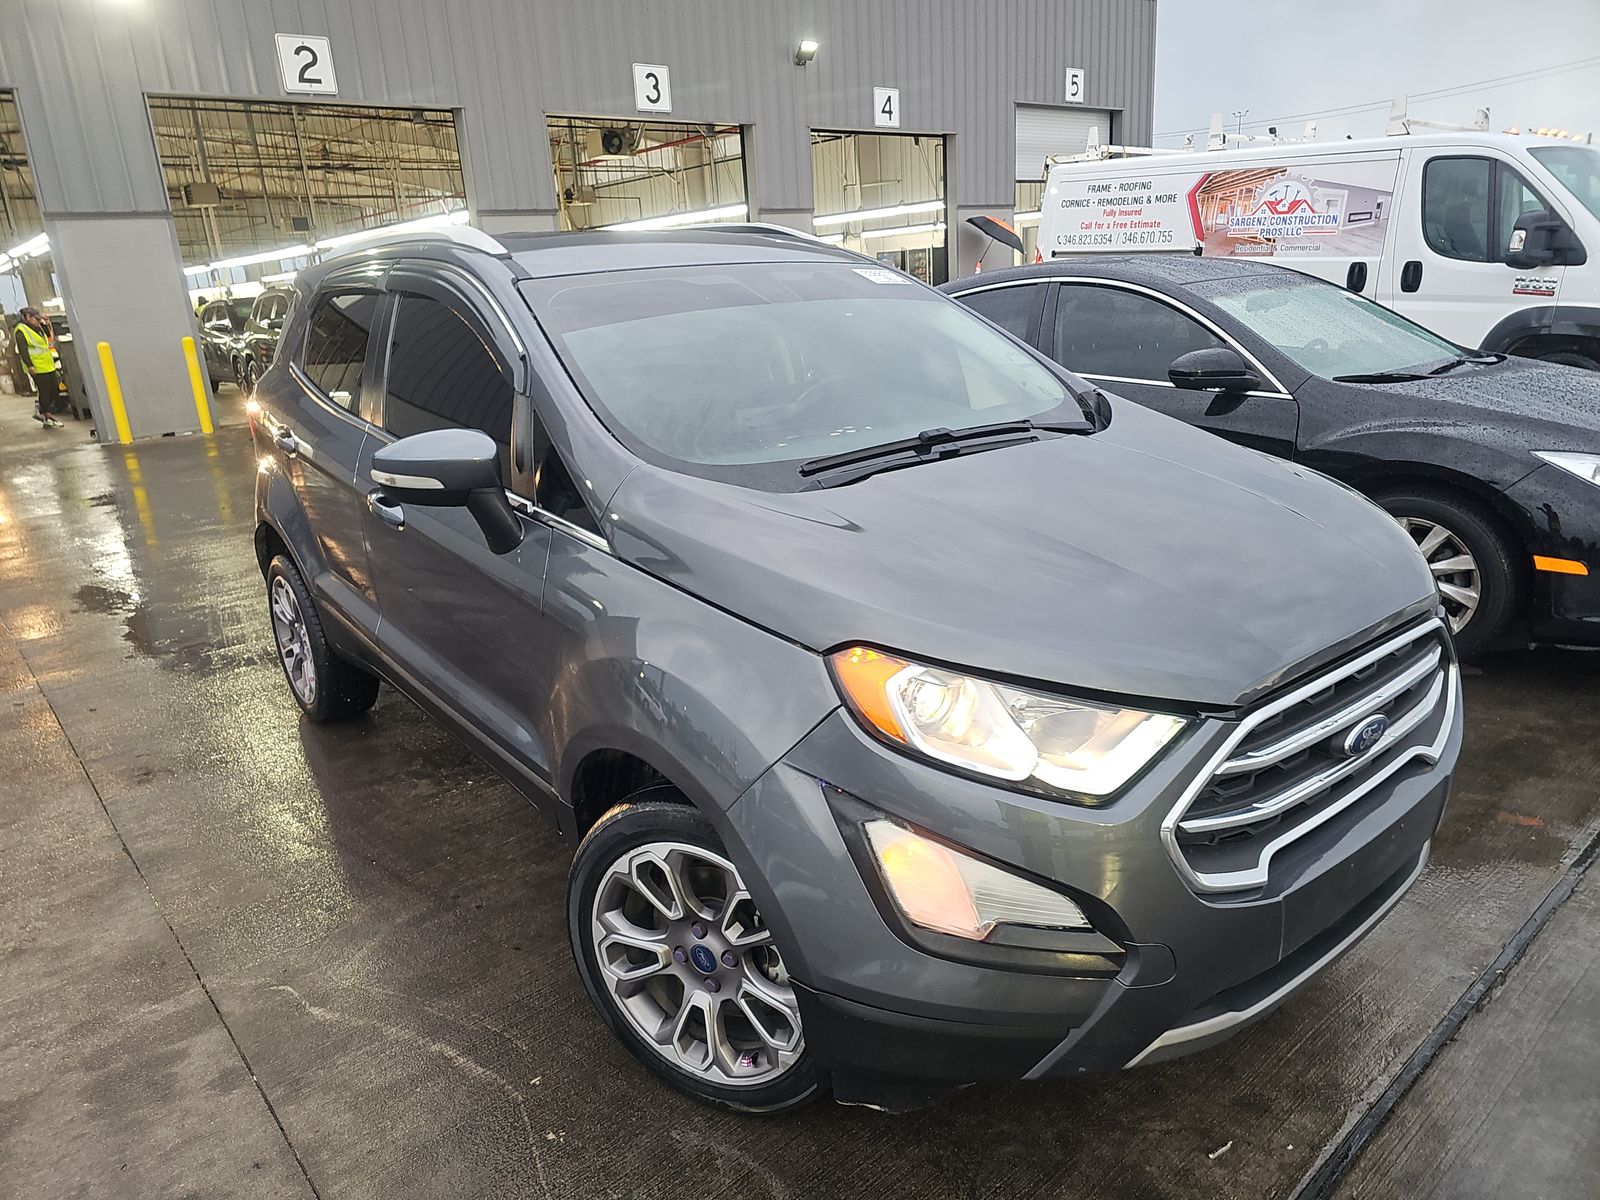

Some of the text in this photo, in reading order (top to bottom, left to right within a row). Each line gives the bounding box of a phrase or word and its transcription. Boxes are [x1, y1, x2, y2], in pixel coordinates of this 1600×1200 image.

[293, 45, 322, 85] 2
[645, 72, 661, 104] 3
[1071, 74, 1079, 96] 5
[881, 95, 893, 121] 4
[1087, 181, 1152, 193] FRAME ROOFING
[1061, 193, 1178, 208] CORNICE REMODELING & MORE
[1103, 208, 1142, 218] Fully Insured
[1080, 221, 1092, 230] Call
[1095, 221, 1104, 229] for
[1113, 221, 1128, 229] Free
[1130, 219, 1161, 229] Estimate
[1229, 214, 1338, 227] SARGENZ CONSTRUCTION
[1063, 233, 1112, 245] 346.823.6354
[1122, 230, 1173, 244] 346.670.755
[1259, 227, 1302, 237] PROS LLC
[1235, 244, 1271, 252] Residential
[1280, 243, 1321, 252] Commercial
